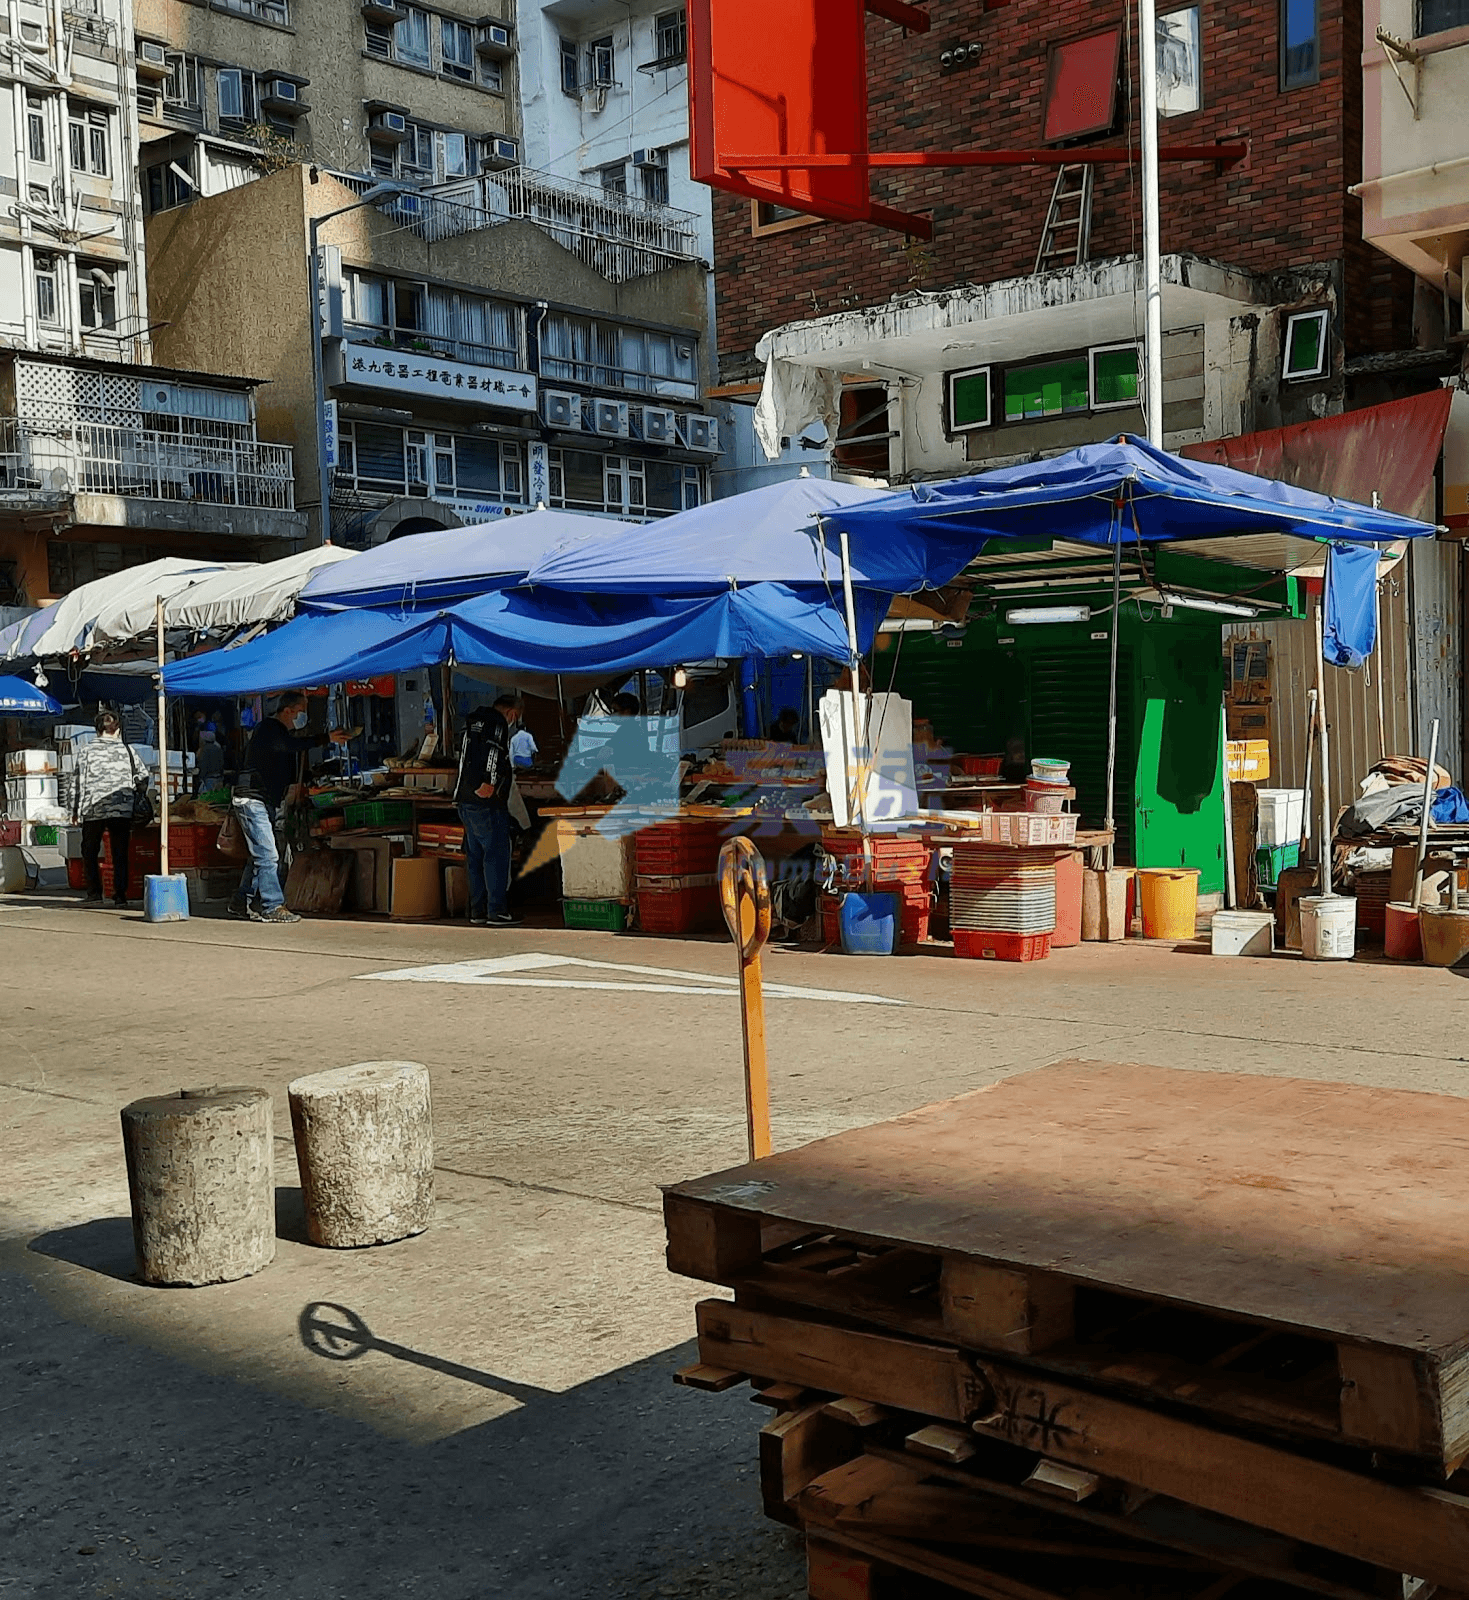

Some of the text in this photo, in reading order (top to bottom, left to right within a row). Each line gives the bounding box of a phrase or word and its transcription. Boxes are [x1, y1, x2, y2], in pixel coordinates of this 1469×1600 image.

[351, 356, 532, 399] 港九電器工程電業器材職工會
[474, 504, 503, 515] SINKO
